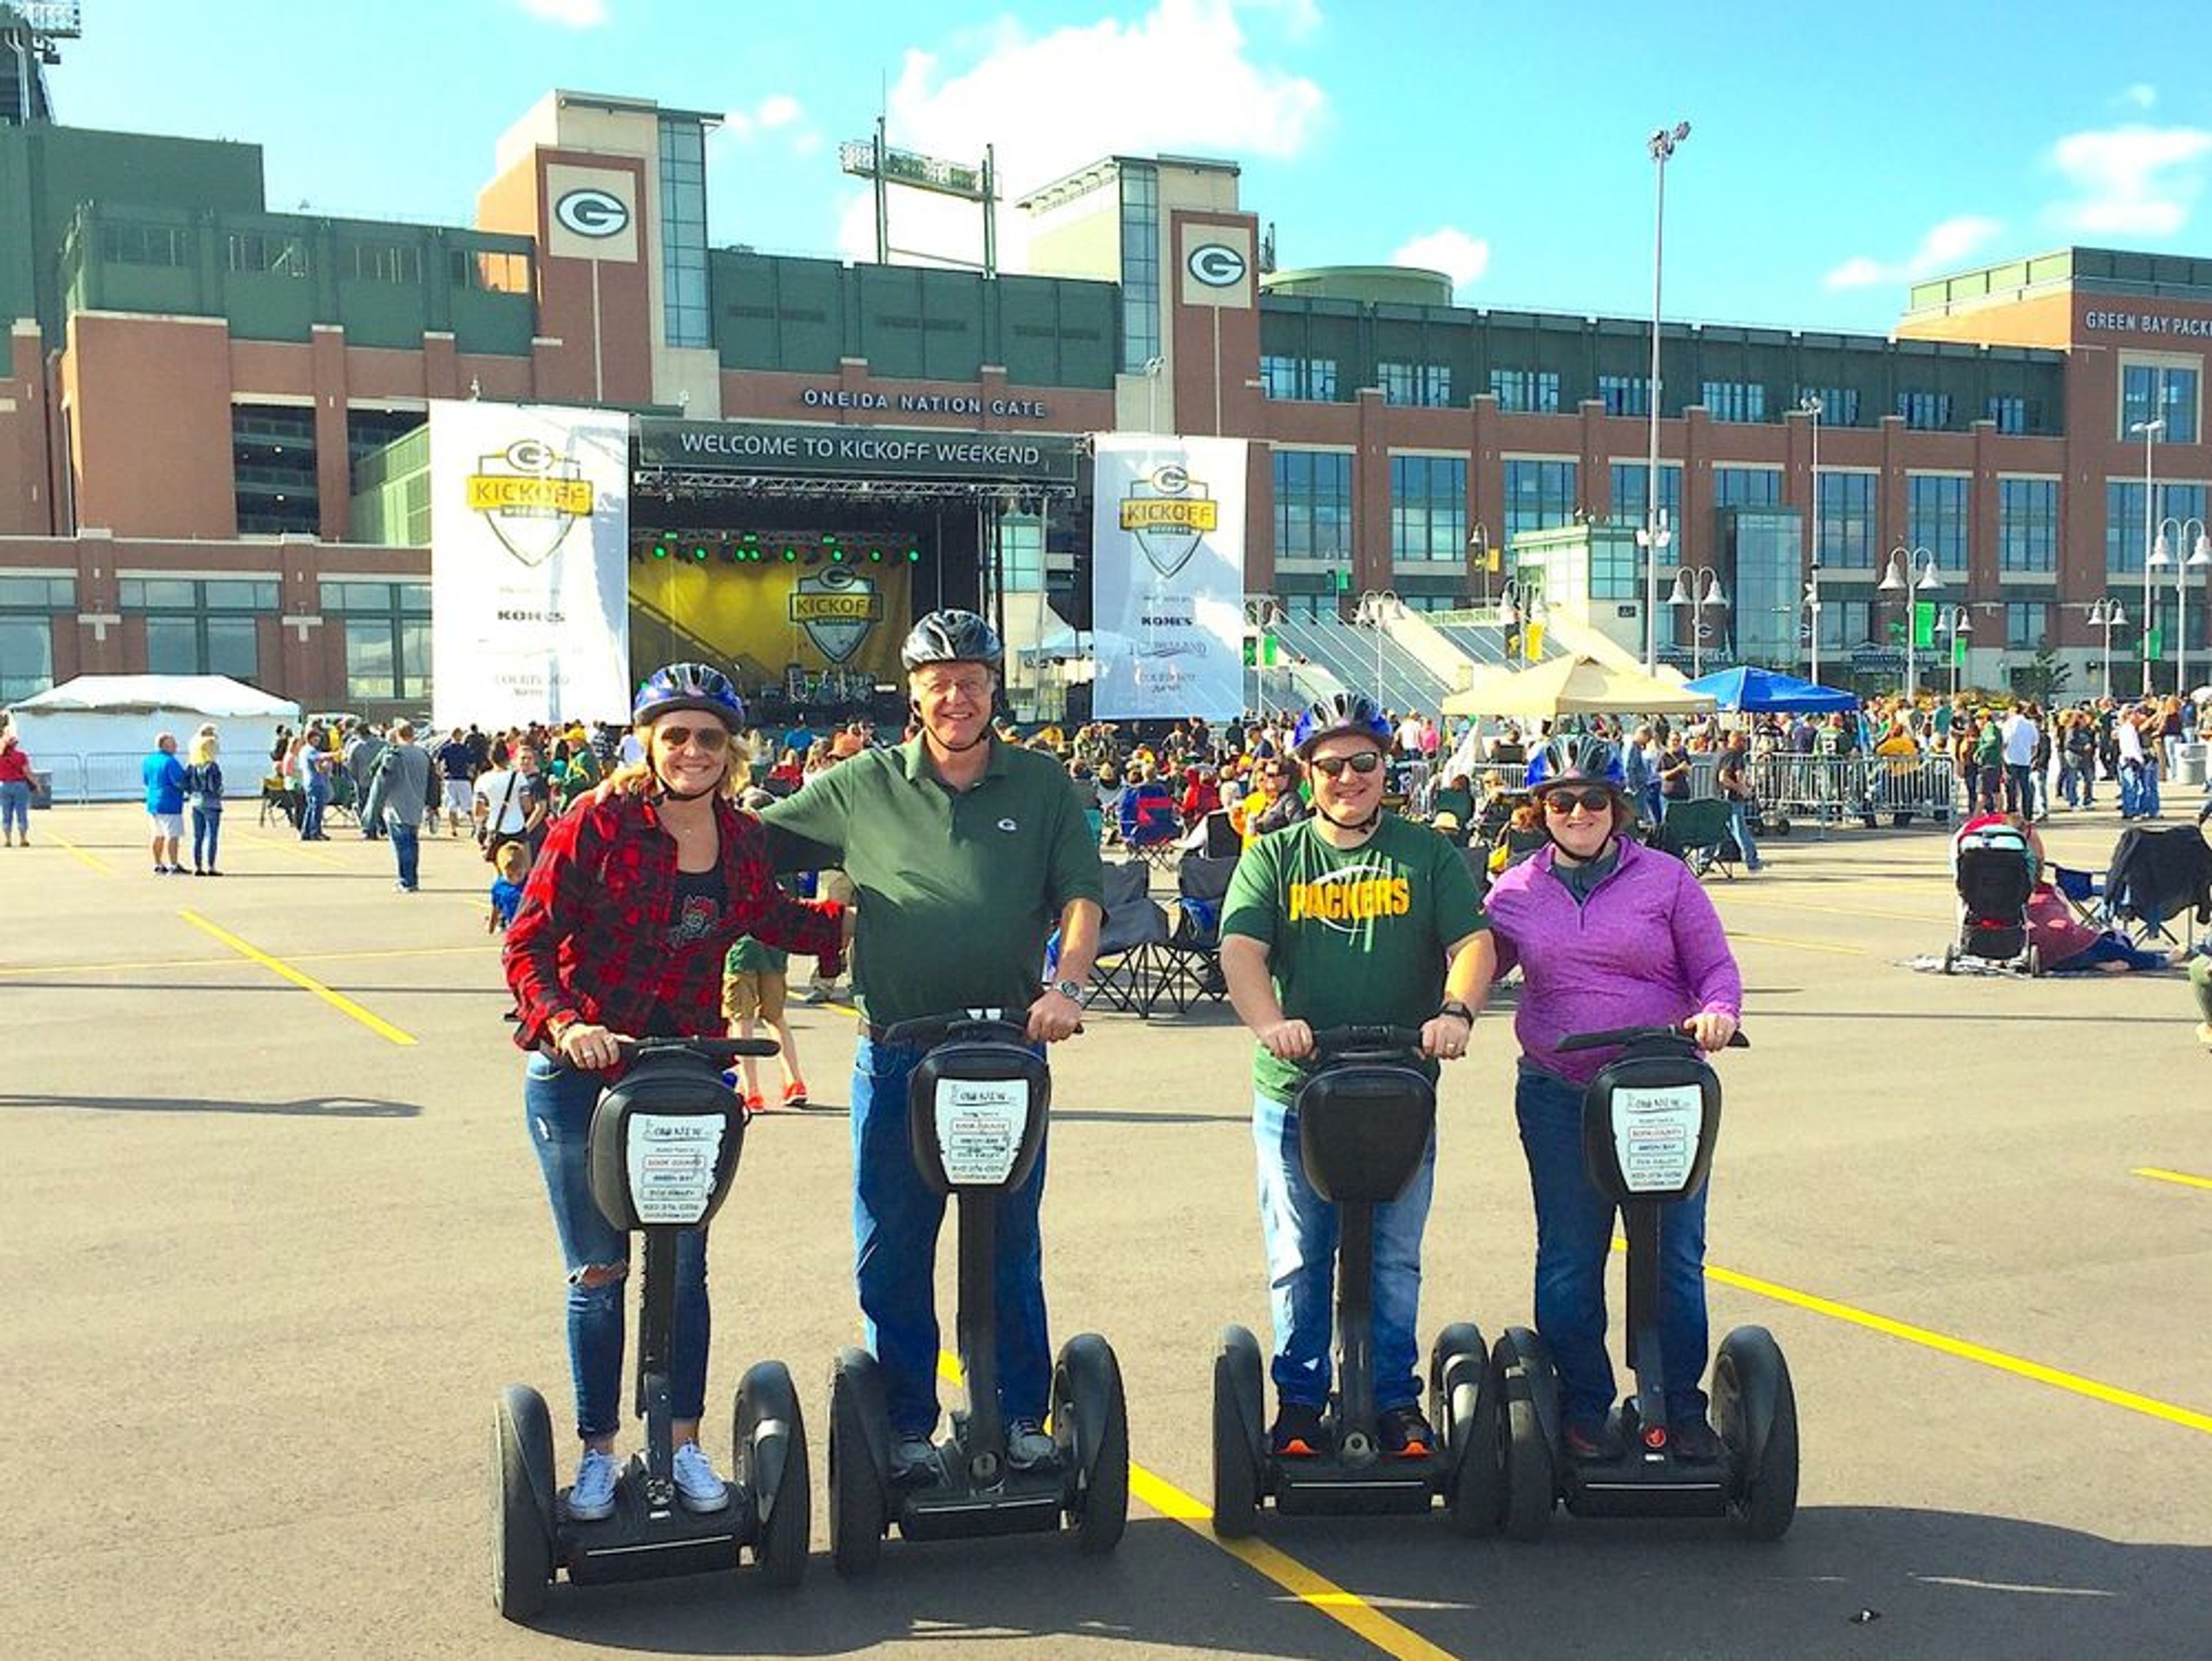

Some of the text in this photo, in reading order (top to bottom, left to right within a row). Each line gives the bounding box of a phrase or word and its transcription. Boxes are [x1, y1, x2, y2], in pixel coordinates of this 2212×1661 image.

[2086, 312, 2135, 330] GREEN
[2141, 316, 2167, 333] BAY
[804, 388, 1046, 417] ONEIDA NATION GATE
[681, 432, 1039, 465] WELCOME TO KICKOFF WEEKEND
[476, 482, 586, 505] KICKOFF
[1127, 504, 1212, 521] KICKOFF
[796, 598, 880, 614] KICKOFF
[1289, 877, 1410, 921] PACKERS
